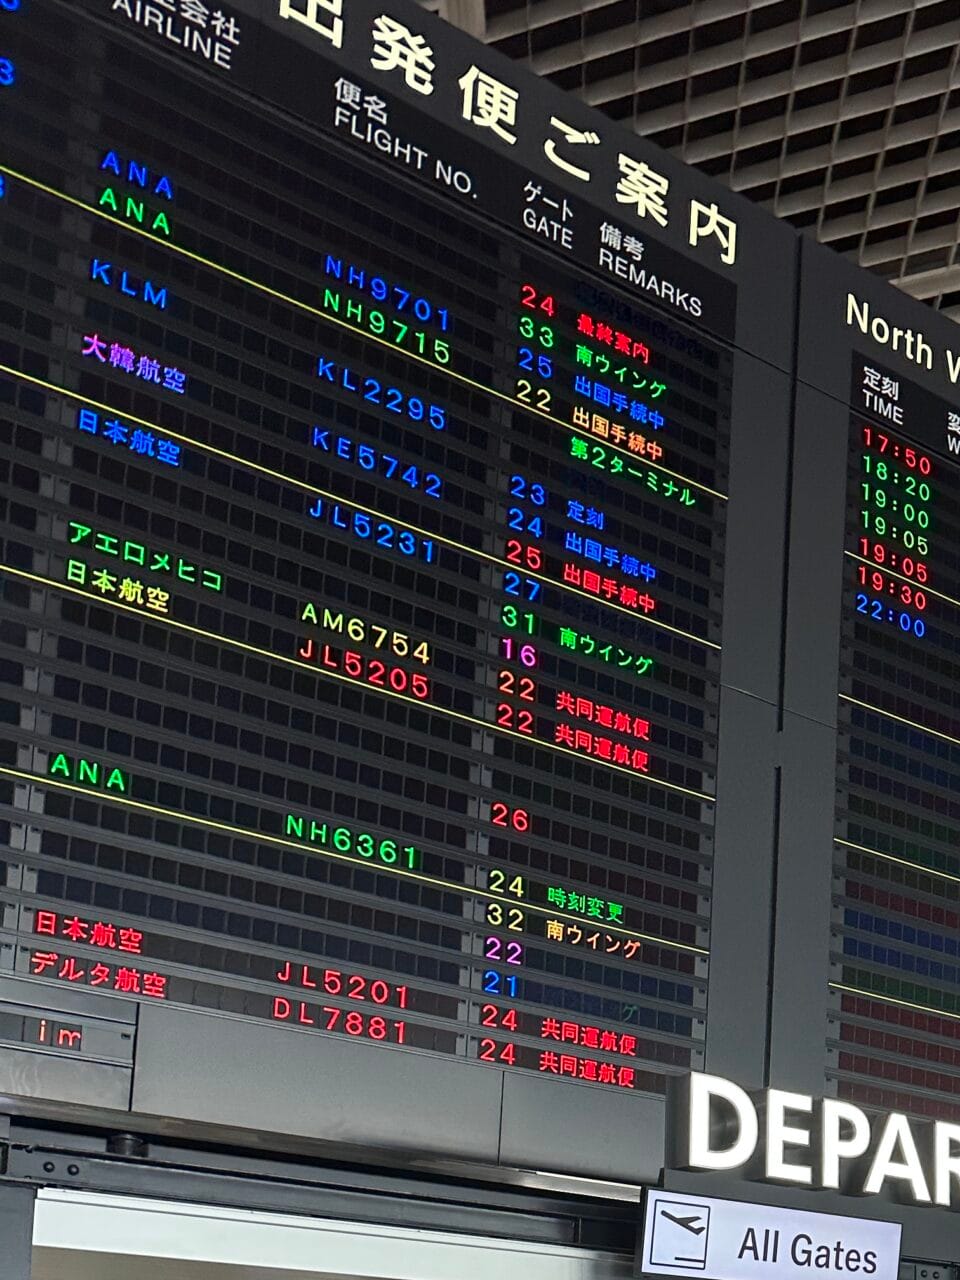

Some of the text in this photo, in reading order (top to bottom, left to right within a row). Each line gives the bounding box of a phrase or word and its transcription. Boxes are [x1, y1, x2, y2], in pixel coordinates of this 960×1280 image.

[112, 0, 232, 69] AIRLINE
[334, 78, 388, 124] 便名
[102, 151, 172, 199] ANA
[334, 107, 477, 198] FLIGHT NO.
[100, 188, 170, 235] ANA
[524, 181, 574, 223] ゲート
[523, 208, 573, 249] GATE
[600, 223, 644, 261] 備考
[91, 259, 167, 309] KLM
[326, 255, 448, 332] NH9701
[521, 285, 555, 317] 24
[599, 248, 702, 316] REMARKS
[323, 289, 450, 364] NH9715
[519, 317, 554, 348] 33
[847, 293, 933, 369] North
[82, 333, 186, 393] 大韓航空
[518, 349, 552, 379] 25
[575, 344, 666, 398] 南ウイング
[863, 366, 899, 401] 定刻
[318, 358, 446, 429] KL2295
[516, 380, 551, 412] 22
[574, 375, 665, 431] 出国手続中
[863, 392, 904, 425] TIME
[79, 408, 180, 466] 日本航空
[573, 406, 663, 461] 出国手続中
[863, 428, 931, 476] 17:50
[312, 427, 442, 498] KE5742
[570, 436, 695, 506] 第2ターミナル
[863, 455, 930, 501] 18:20
[510, 476, 545, 506] 23
[861, 483, 929, 528] 19:00
[310, 499, 434, 562] JL5231
[508, 508, 543, 538] 24
[567, 501, 604, 530] 定刻
[861, 510, 928, 556] 19:05
[69, 521, 221, 591] アエロメヒコ
[507, 540, 542, 570] 25
[565, 532, 656, 582] 出国手続中
[860, 538, 927, 582] 19:05
[67, 559, 169, 613] 日本航空
[504, 572, 540, 601] 27
[563, 563, 655, 613] 出国手続中
[858, 566, 926, 610] 19:30
[301, 603, 430, 664] AM6754
[502, 606, 535, 634] 31
[857, 594, 925, 638] 22:00
[300, 639, 428, 698] JL5205
[502, 638, 536, 667] 16
[560, 627, 653, 674] 南ウイング
[499, 671, 535, 701] 22
[497, 703, 533, 734] 22
[556, 691, 650, 741] 共同運航便
[555, 723, 648, 772] 共同運航便
[51, 753, 125, 791] ANA
[492, 803, 528, 832] 26
[286, 814, 418, 869] NH6361
[489, 869, 524, 898] 24
[547, 887, 624, 924] 時刻変更
[36, 910, 143, 954] 日本航空
[486, 903, 524, 932] 32
[546, 920, 641, 959] 南ウイング
[485, 937, 522, 965] 22
[31, 951, 167, 999] デルタ航空
[277, 961, 407, 1009] JL5201
[484, 971, 519, 998] 21
[273, 998, 406, 1044] DL7881
[482, 1004, 518, 1031] 24
[541, 1018, 637, 1057] 共同運航便
[480, 1038, 516, 1065] 24
[539, 1051, 635, 1088] 共同運航便
[738, 1226, 878, 1276] All Gates
